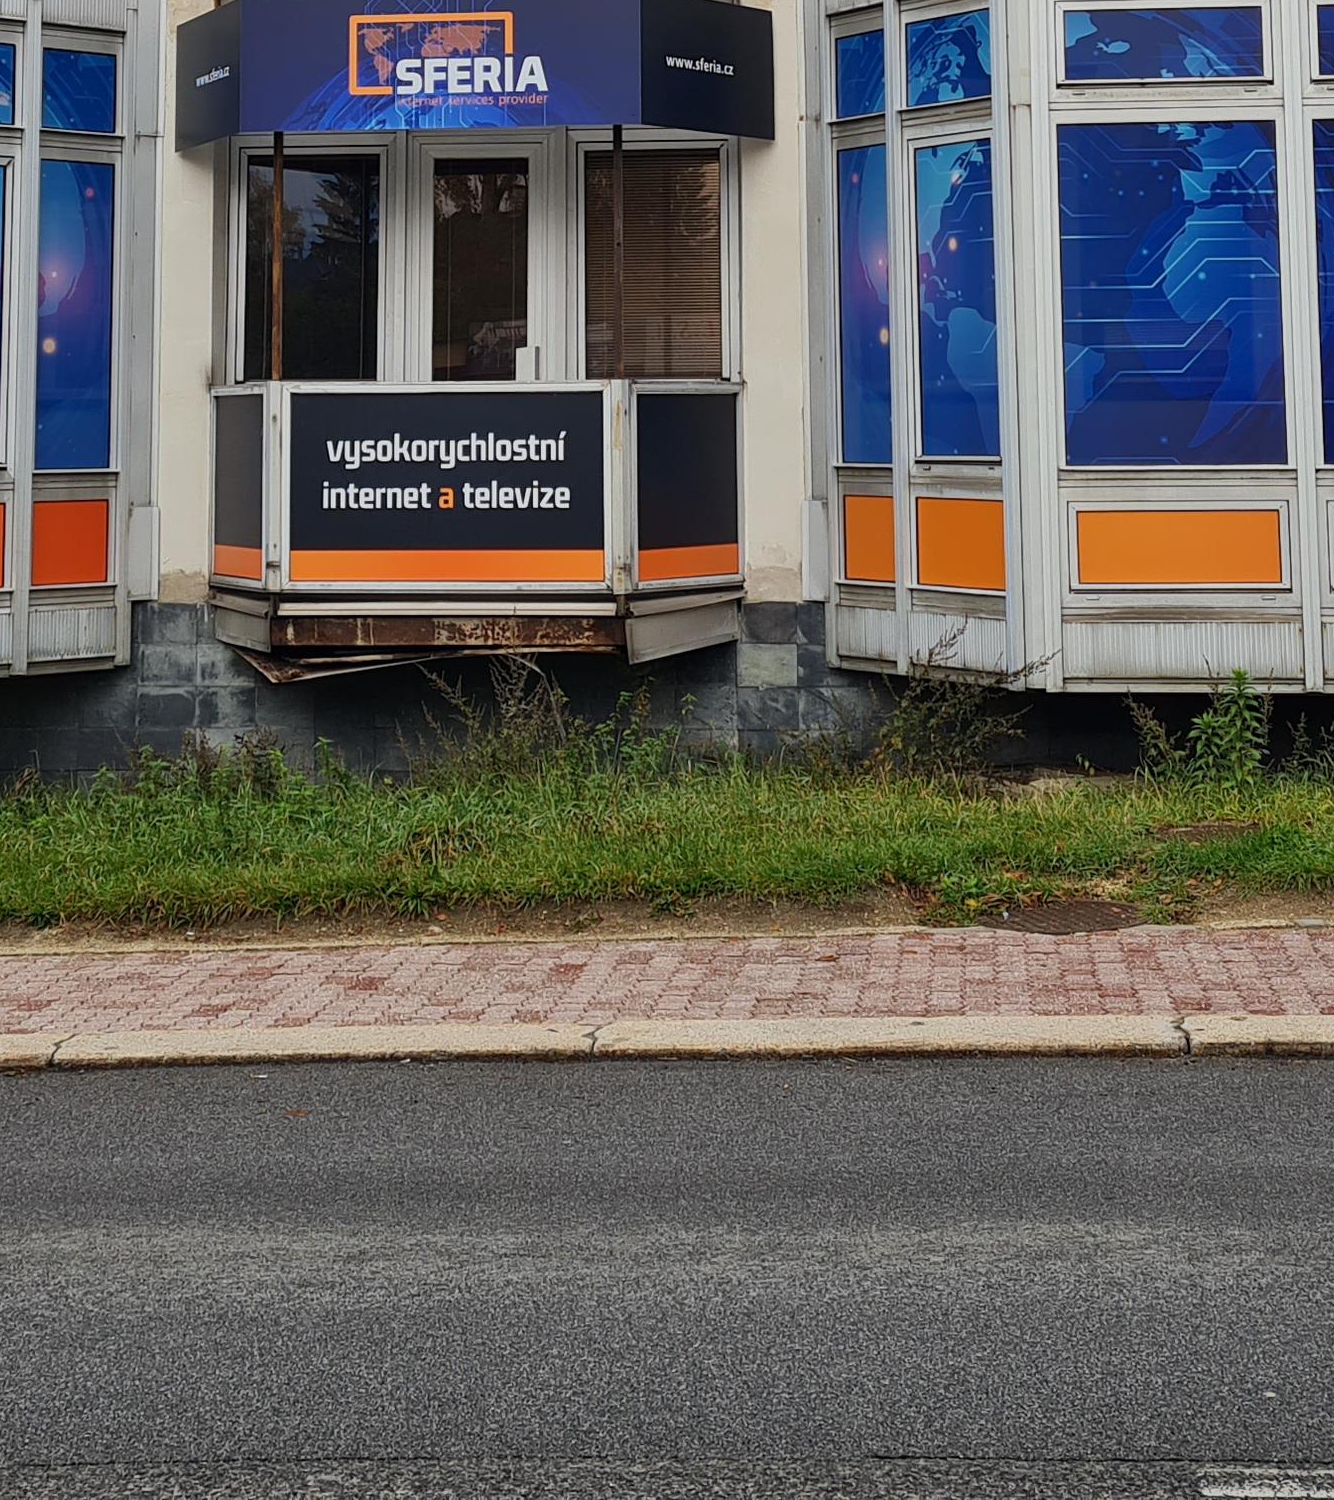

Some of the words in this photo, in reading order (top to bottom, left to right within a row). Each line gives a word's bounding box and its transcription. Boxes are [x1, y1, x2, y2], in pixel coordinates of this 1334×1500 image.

[395, 55, 549, 95] SFERIA
[665, 55, 735, 76] www.sferia.cz
[498, 94, 549, 108] provider
[326, 430, 567, 470] vysokorychlostní
[322, 481, 432, 510] internet
[438, 486, 455, 509] a
[462, 480, 571, 509] televize
